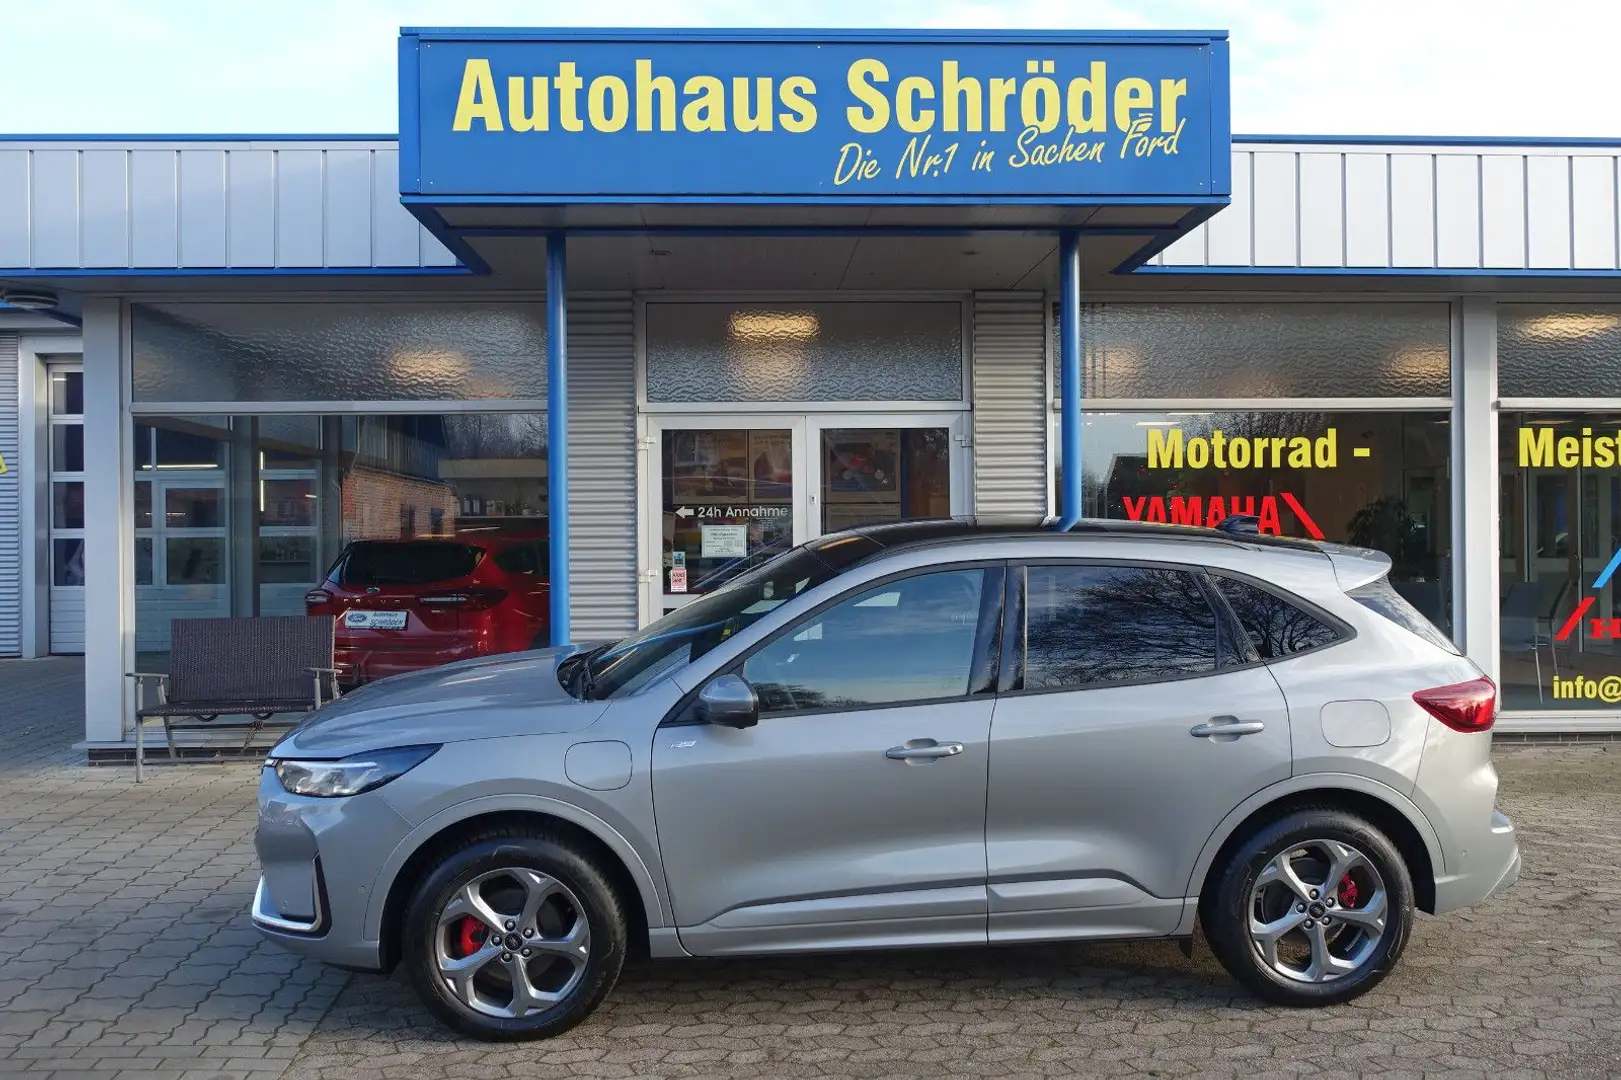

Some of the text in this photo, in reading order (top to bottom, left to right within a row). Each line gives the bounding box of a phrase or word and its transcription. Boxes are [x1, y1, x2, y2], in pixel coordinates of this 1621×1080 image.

[452, 58, 1187, 134] Autohaus Schröder
[834, 113, 1186, 185] Die Nr.1 in Sachen Ford
[1147, 427, 1337, 469] Motorrad
[697, 506, 788, 518] 24h Annahme
